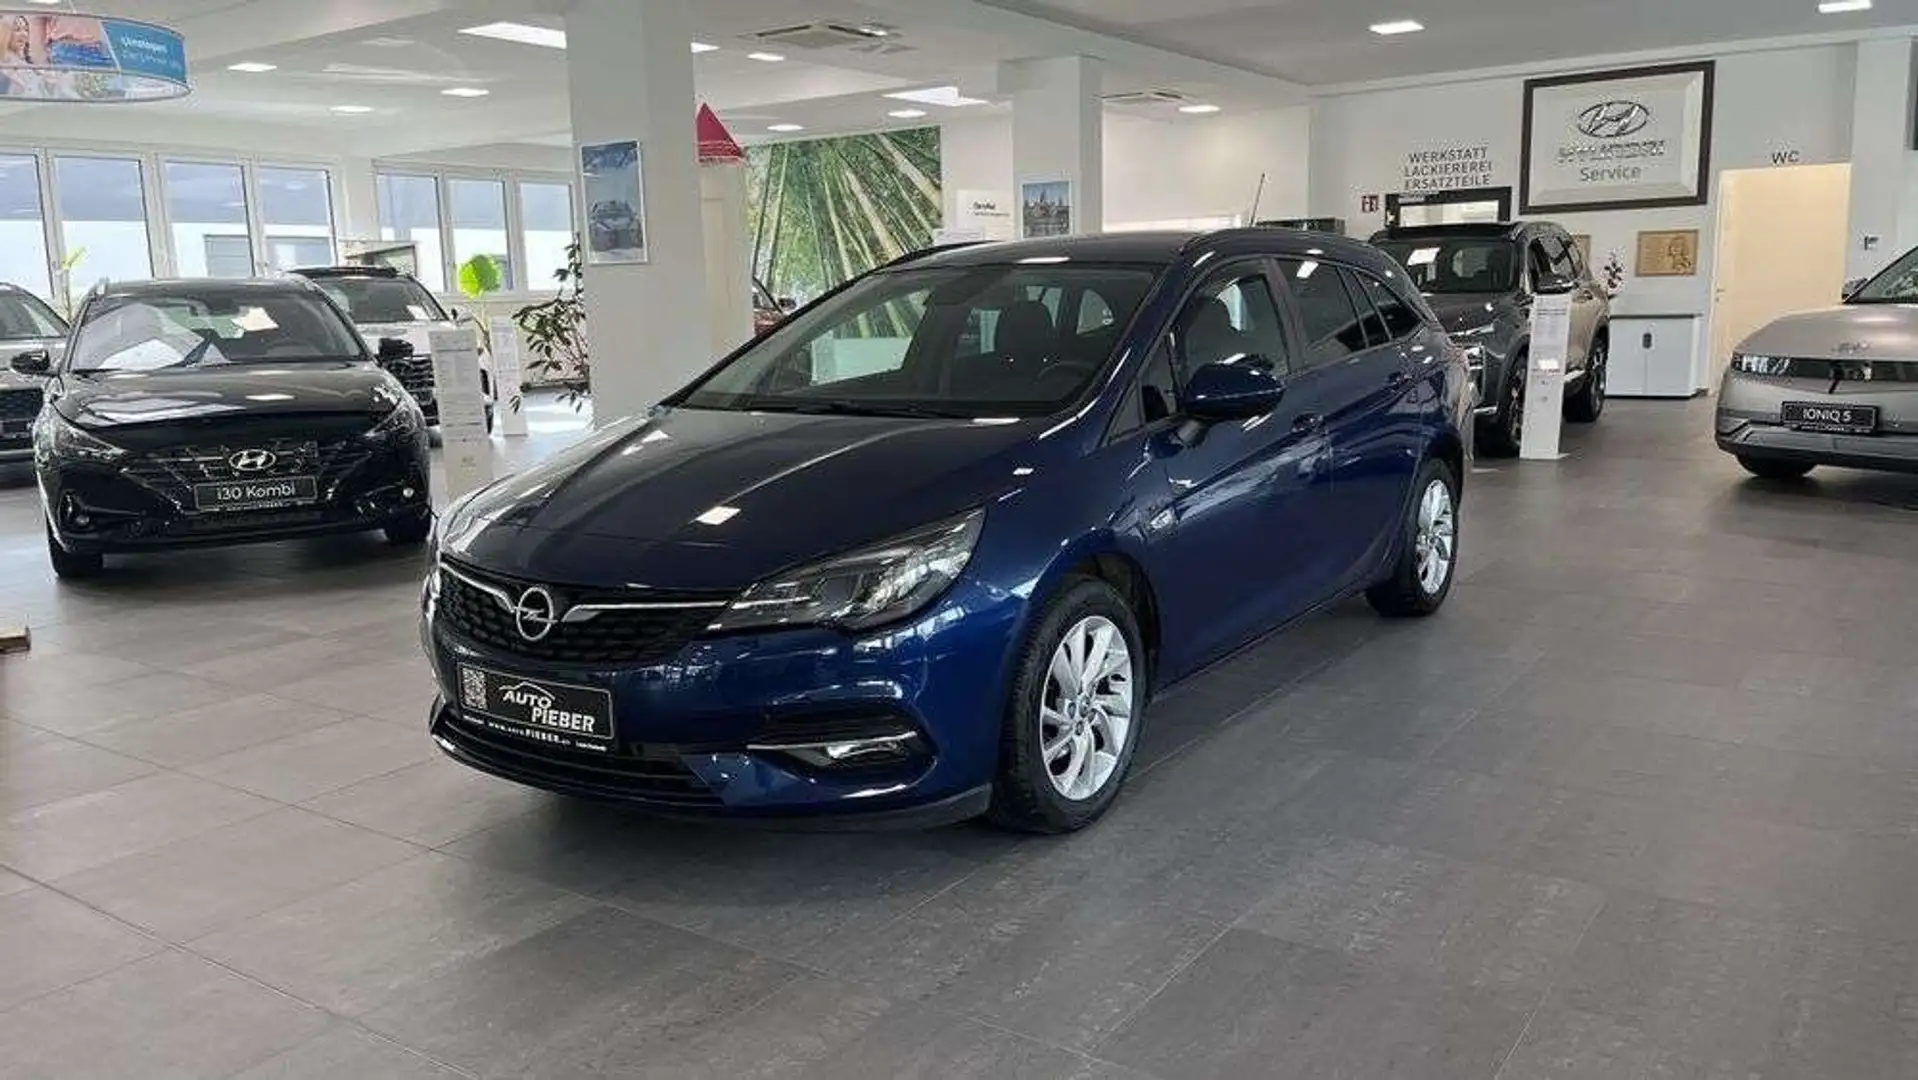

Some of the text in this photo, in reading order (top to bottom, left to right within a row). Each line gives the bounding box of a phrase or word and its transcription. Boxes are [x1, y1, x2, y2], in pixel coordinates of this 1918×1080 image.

[1408, 147, 1488, 162] WERKSTATT
[1772, 150, 1799, 164] WC
[1580, 165, 1641, 181] Service
[1803, 408, 1841, 423] IONIQ
[217, 481, 295, 500] i30 Kombi
[503, 690, 552, 709] AUTO
[531, 707, 595, 733] PIEBER
